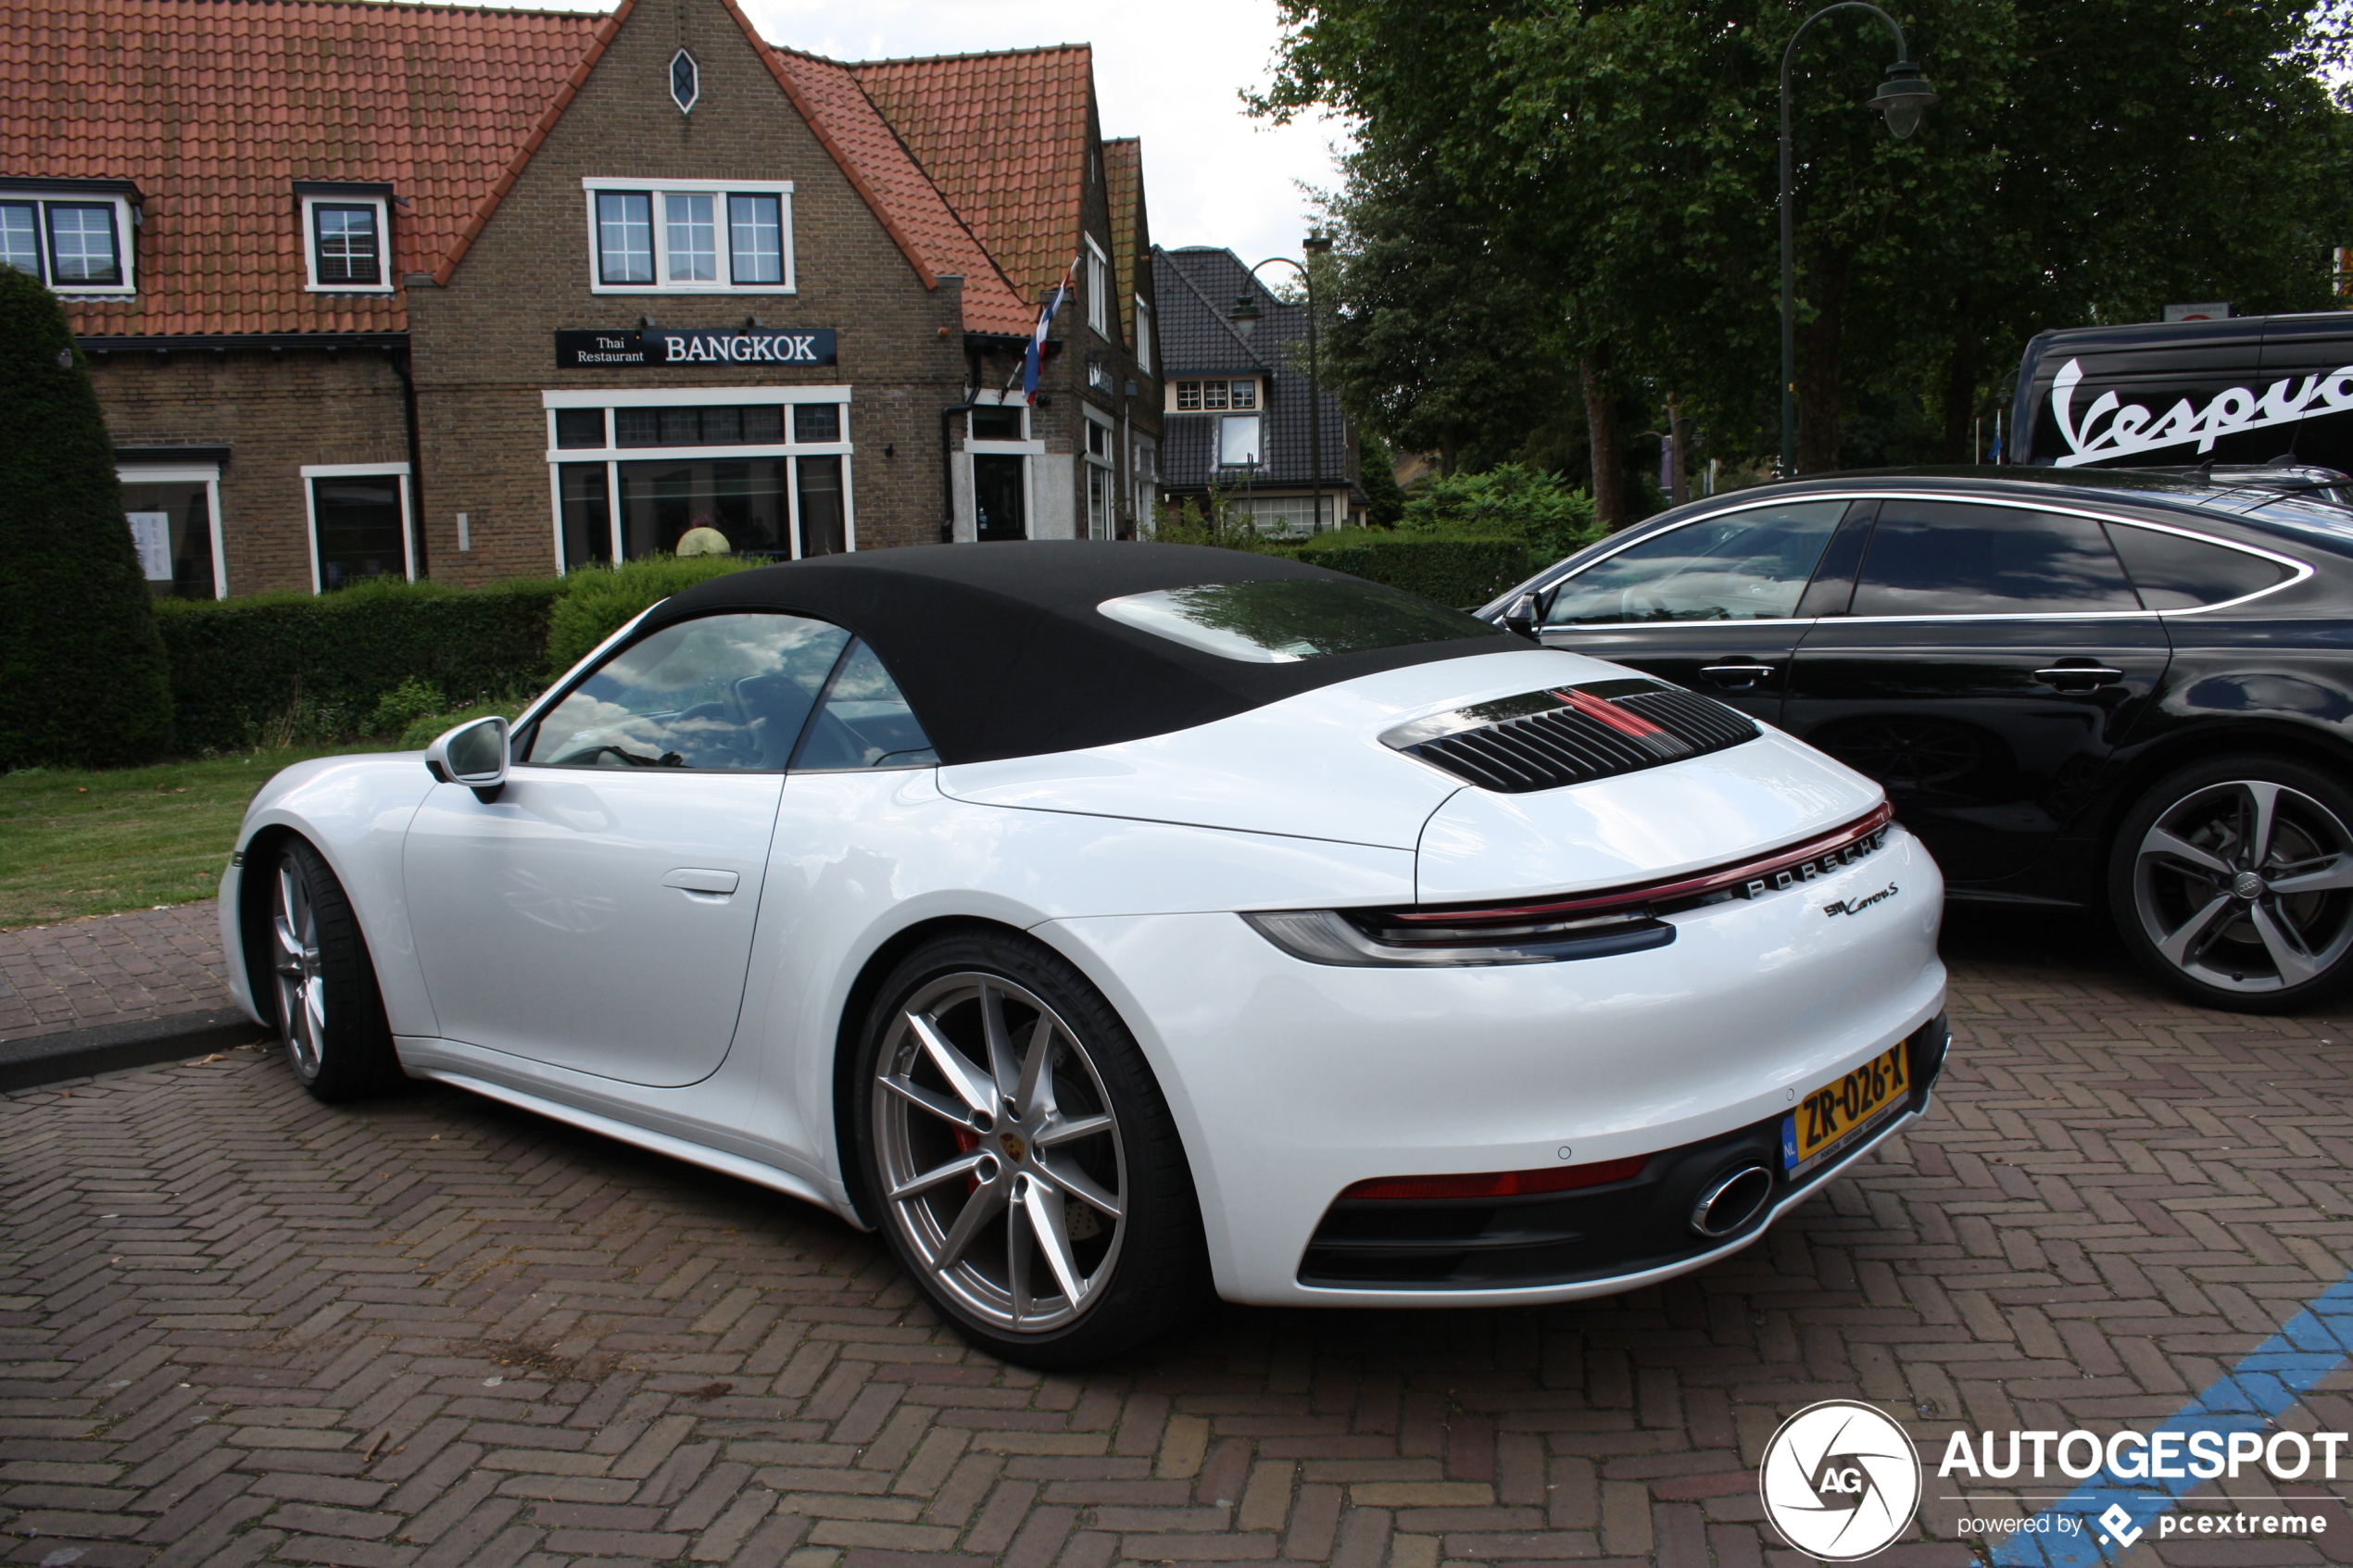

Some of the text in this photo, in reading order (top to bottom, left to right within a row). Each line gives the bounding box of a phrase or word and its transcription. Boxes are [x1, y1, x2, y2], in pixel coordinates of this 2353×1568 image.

[596, 336, 625, 349] Thai
[664, 335, 816, 362] BANGKOK
[576, 350, 645, 362] Restaurant
[1747, 832, 1885, 900] PORSCHE
[1888, 881, 1899, 897] S
[1804, 1041, 1905, 1149] ZR-026-X
[1783, 1142, 1796, 1159] NL
[1819, 1142, 1841, 1160] PORSCHE
